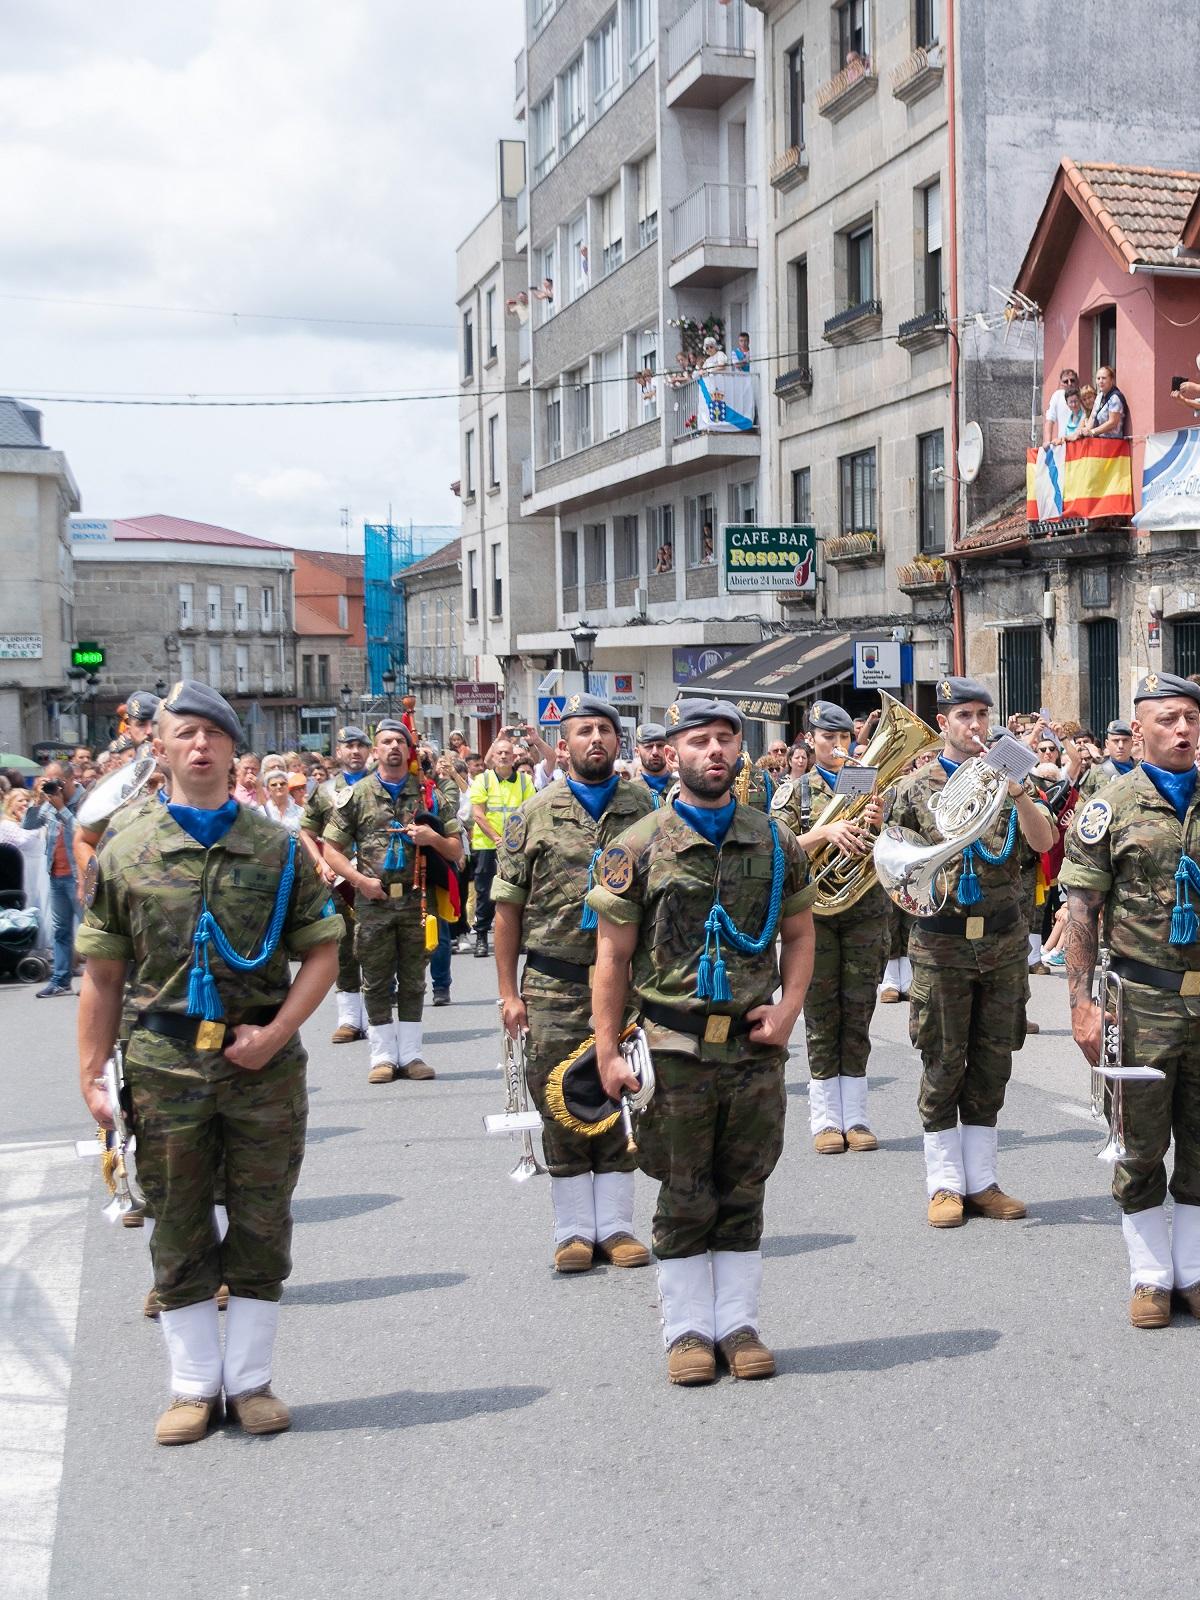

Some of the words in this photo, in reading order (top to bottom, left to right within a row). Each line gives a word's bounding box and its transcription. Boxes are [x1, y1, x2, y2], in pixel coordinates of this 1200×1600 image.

[729, 575, 759, 586] Abierto
[760, 576, 770, 585] 24
[772, 575, 794, 585] horas
